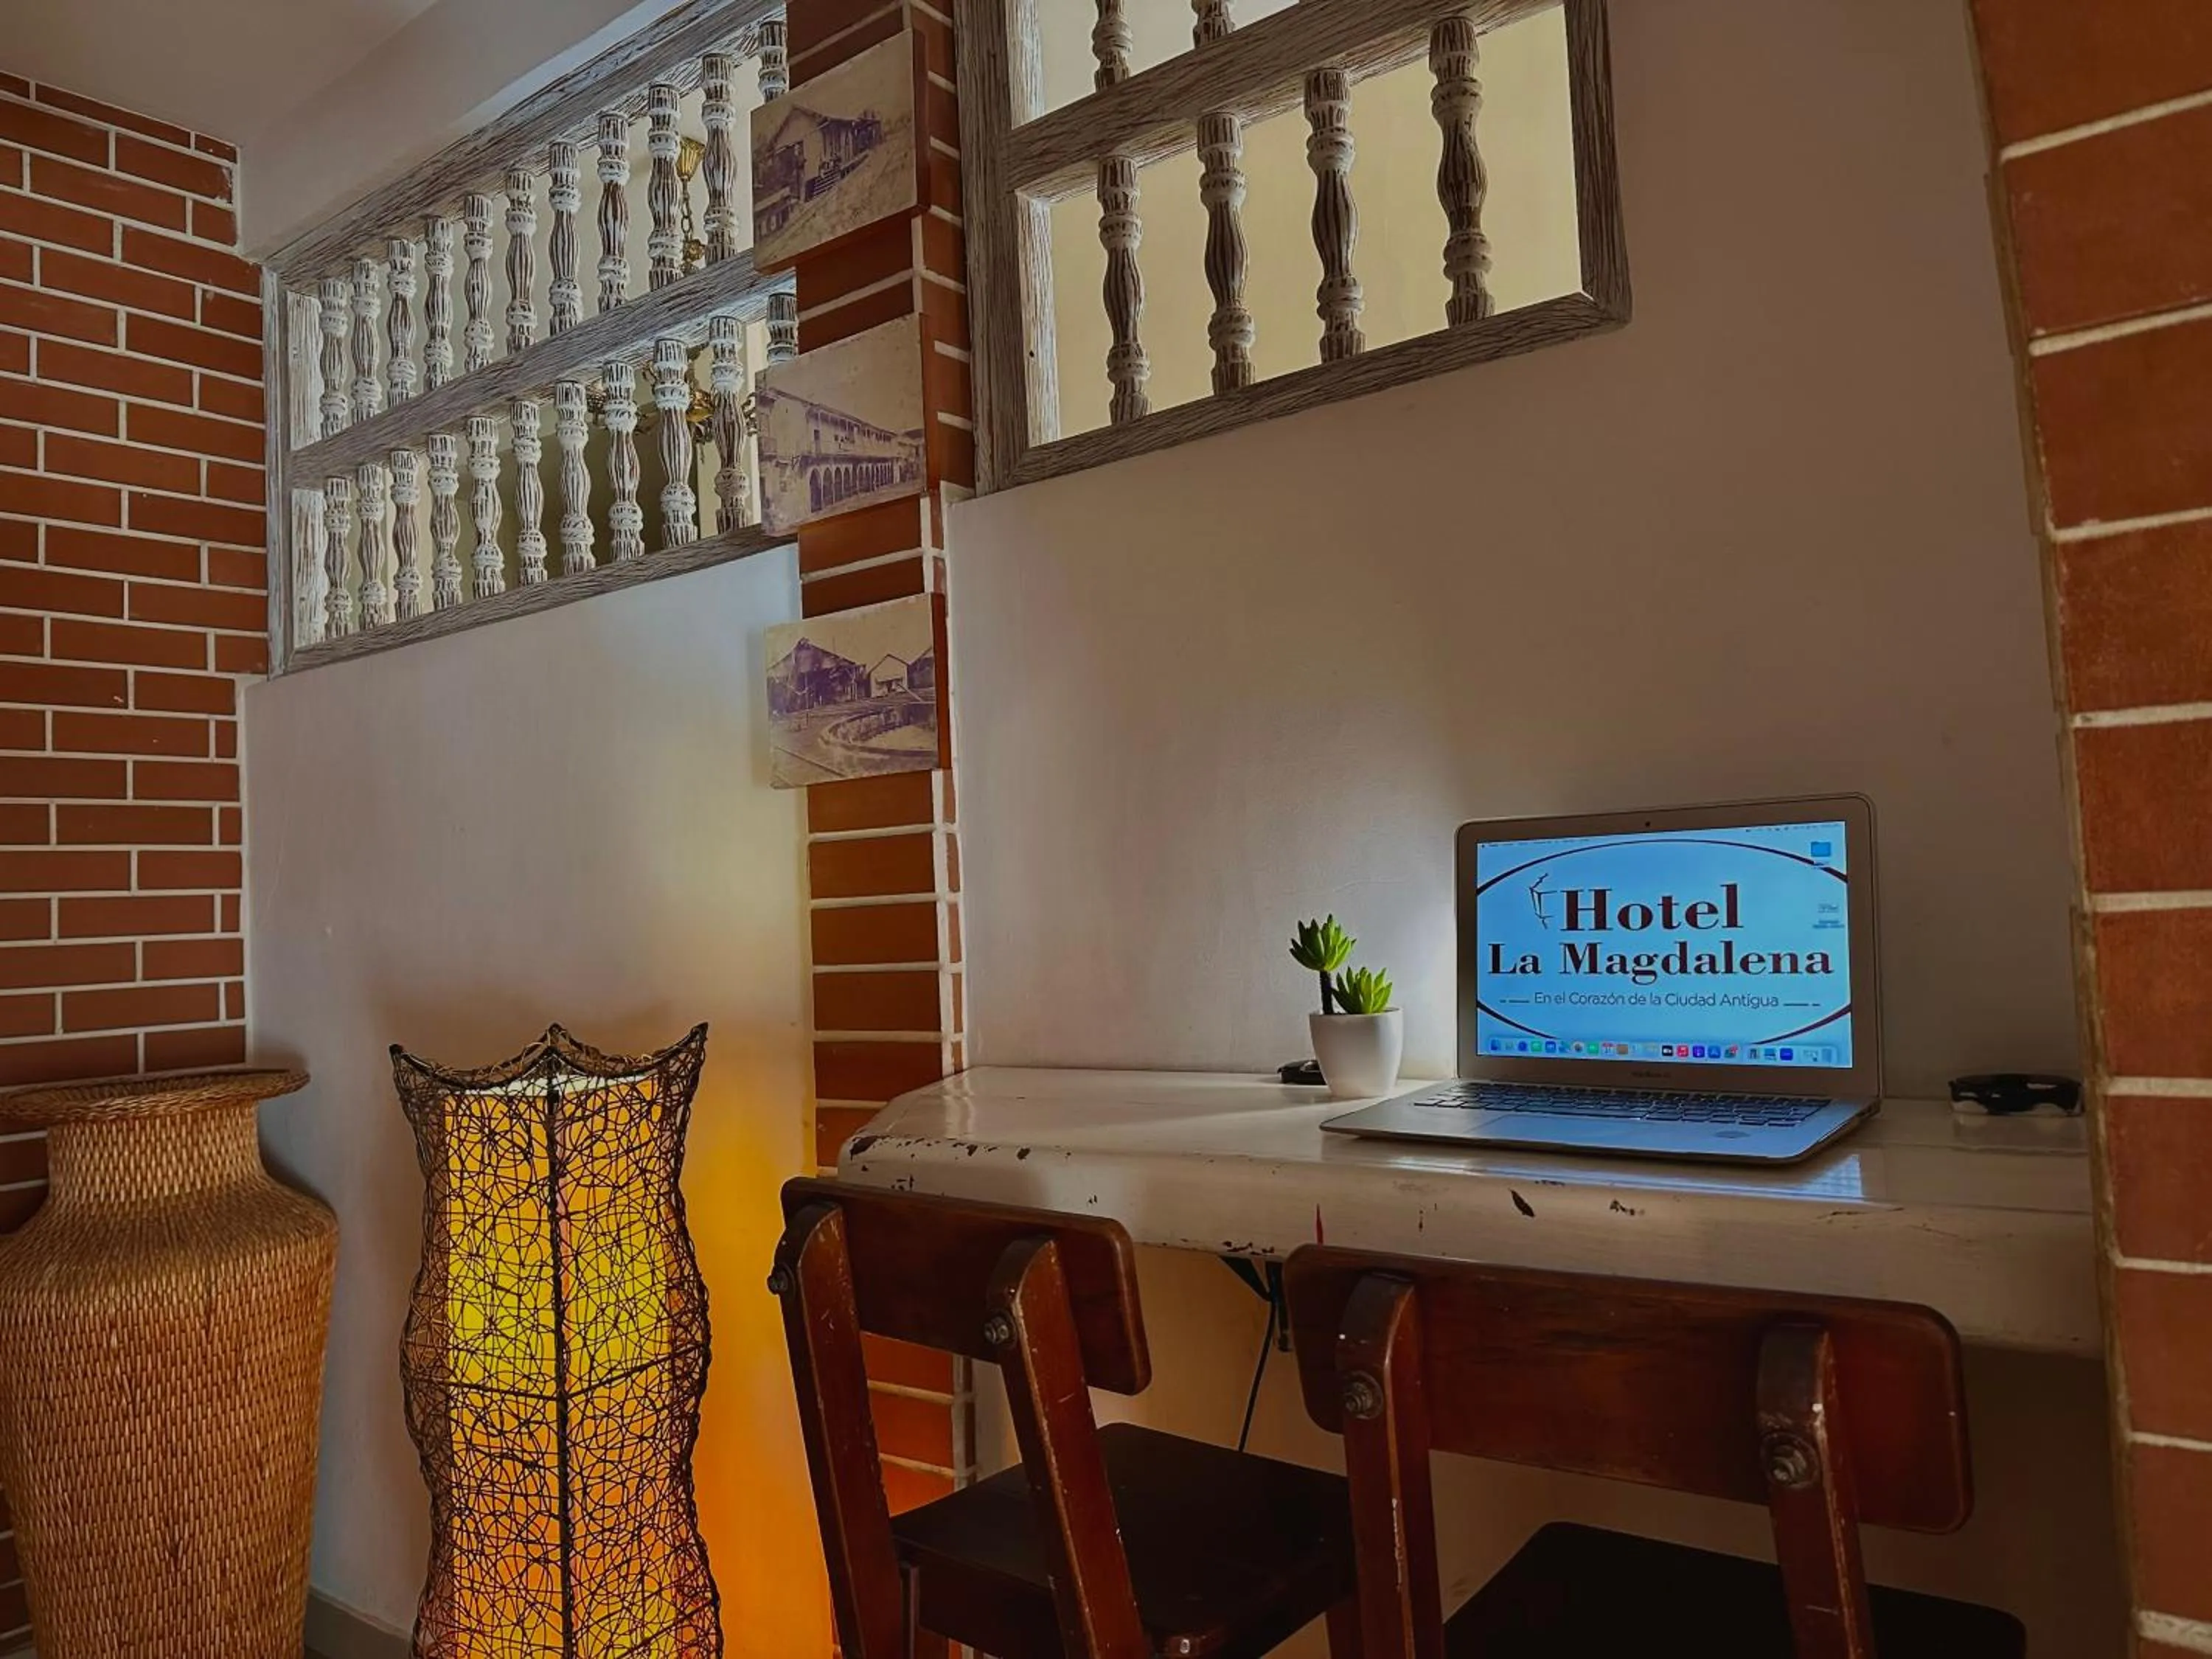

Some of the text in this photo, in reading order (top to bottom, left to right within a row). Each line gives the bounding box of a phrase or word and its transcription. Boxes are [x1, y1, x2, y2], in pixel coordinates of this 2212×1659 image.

[1560, 883, 1744, 931] Hotel
[1488, 940, 1834, 986] La Magdalena
[1534, 991, 1779, 1009] En el Corazón de la Ciudad Antigua
